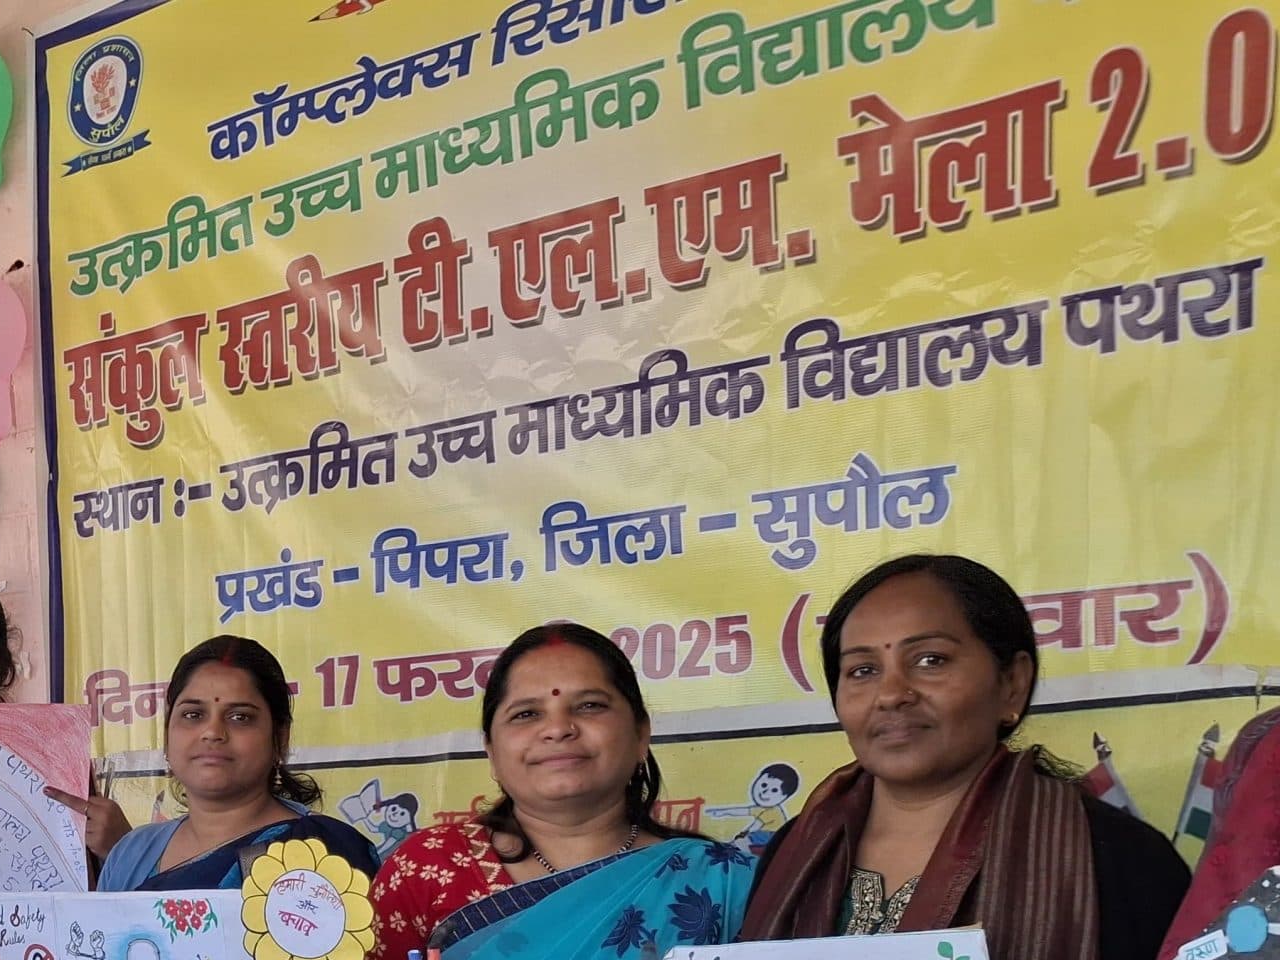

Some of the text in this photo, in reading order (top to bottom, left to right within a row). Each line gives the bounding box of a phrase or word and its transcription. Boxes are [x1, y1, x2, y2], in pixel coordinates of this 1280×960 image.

[68, 0, 995, 296] उत्क्रमित उच्च माध्यमिक विद्यालय
[208, 33, 482, 163] कॉम्प्लेक्स
[64, 312, 210, 450] संकुल
[216, 254, 393, 395] स्तरीय
[837, 94, 1067, 241] मेला
[1087, 8, 1277, 195] 2.0
[220, 421, 400, 516] उत्क्रमित
[407, 411, 497, 479] उच्च
[506, 349, 770, 457] माध्यमिक
[781, 300, 1049, 408] विद्यालय
[1061, 257, 1265, 354] पथरा
[216, 548, 323, 623] प्रखंड
[371, 527, 524, 595] पिपरा,
[539, 500, 686, 573] जिला
[752, 452, 958, 571] सुपौल
[314, 654, 360, 708] 17
[610, 614, 753, 681] 2025
[0, 929, 26, 947] Rules
[10, 904, 46, 933] Safety
[274, 872, 306, 896] हमारी
